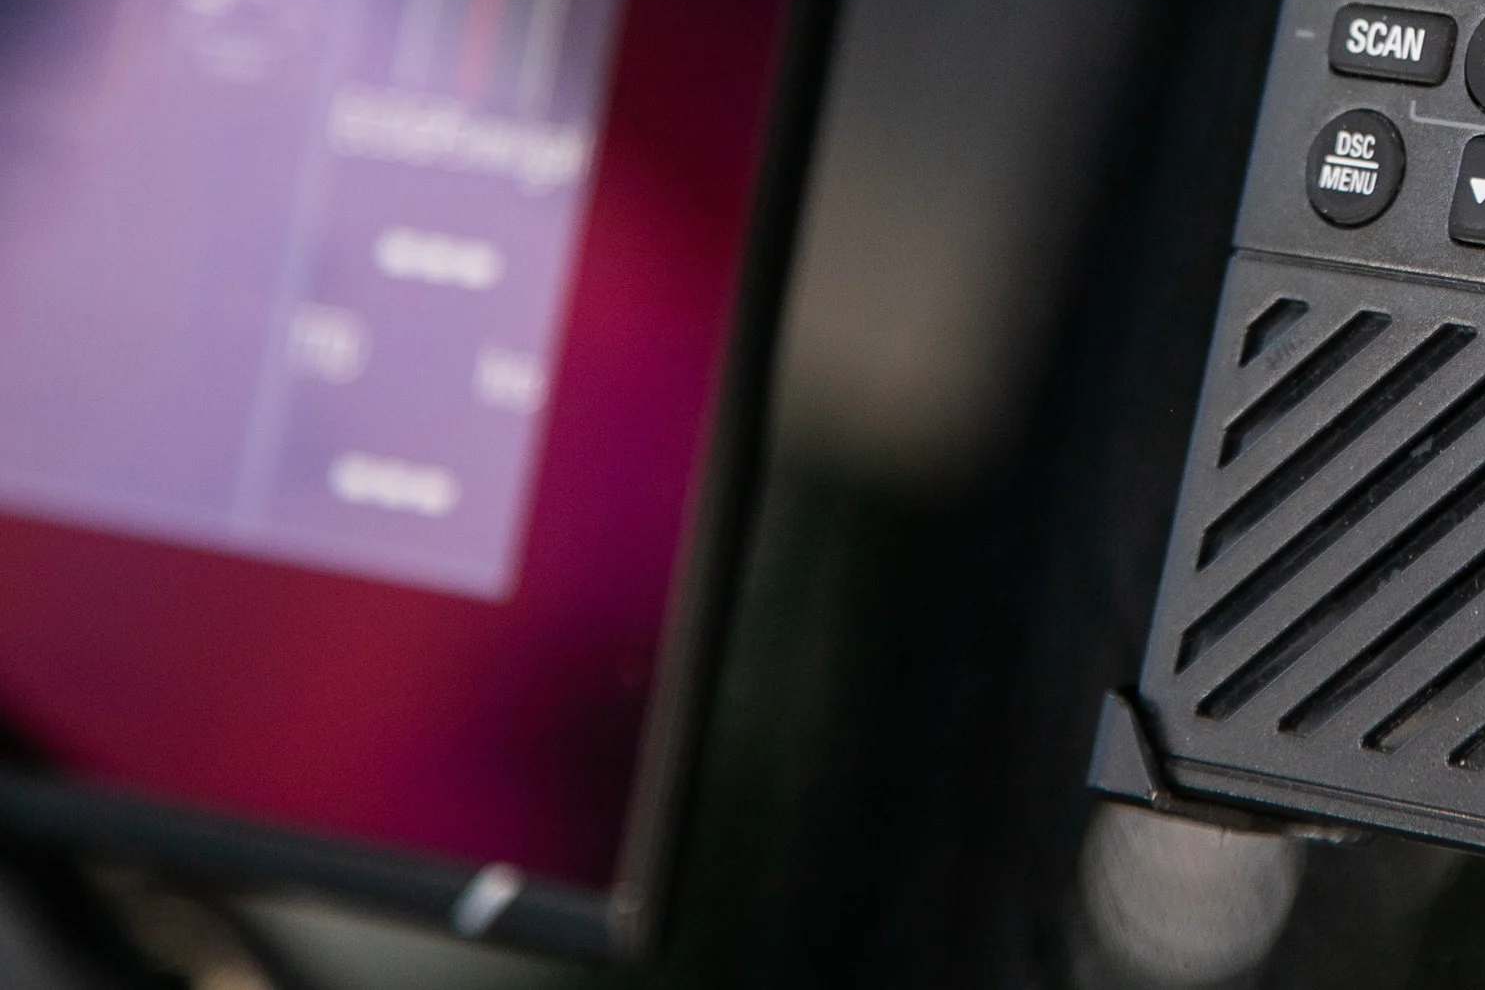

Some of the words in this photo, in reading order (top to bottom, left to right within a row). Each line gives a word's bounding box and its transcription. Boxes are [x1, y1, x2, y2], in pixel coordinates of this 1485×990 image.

[1346, 18, 1426, 62] SCAN
[1335, 130, 1376, 160] DSC
[1318, 164, 1378, 196] MENU
